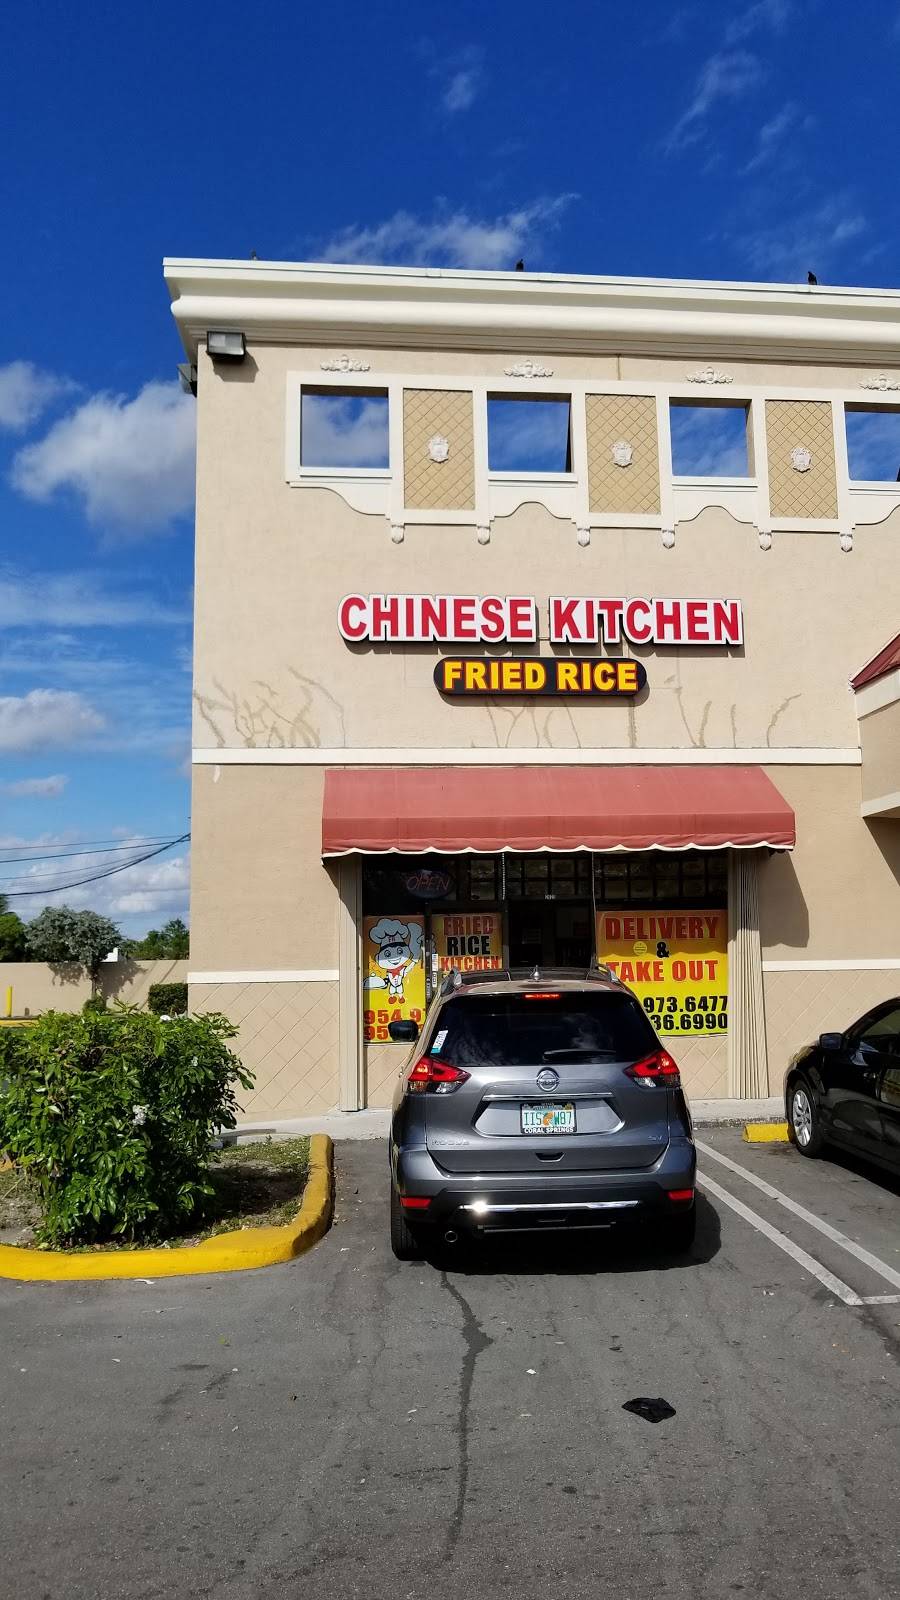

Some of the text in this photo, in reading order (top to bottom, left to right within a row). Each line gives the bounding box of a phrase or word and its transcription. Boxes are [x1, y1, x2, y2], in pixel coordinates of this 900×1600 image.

[340, 596, 741, 643] CHINESE KITCHEN
[442, 660, 639, 693] FRIED RICE
[406, 875, 449, 892] OPEN
[443, 916, 495, 936] FRIED
[605, 917, 718, 940] DELIVERY
[447, 936, 491, 956] RICE
[656, 941, 670, 958] &
[440, 956, 500, 971] KITCHEN
[606, 960, 718, 982] TAKE OUT
[643, 996, 728, 1013] 973.6477
